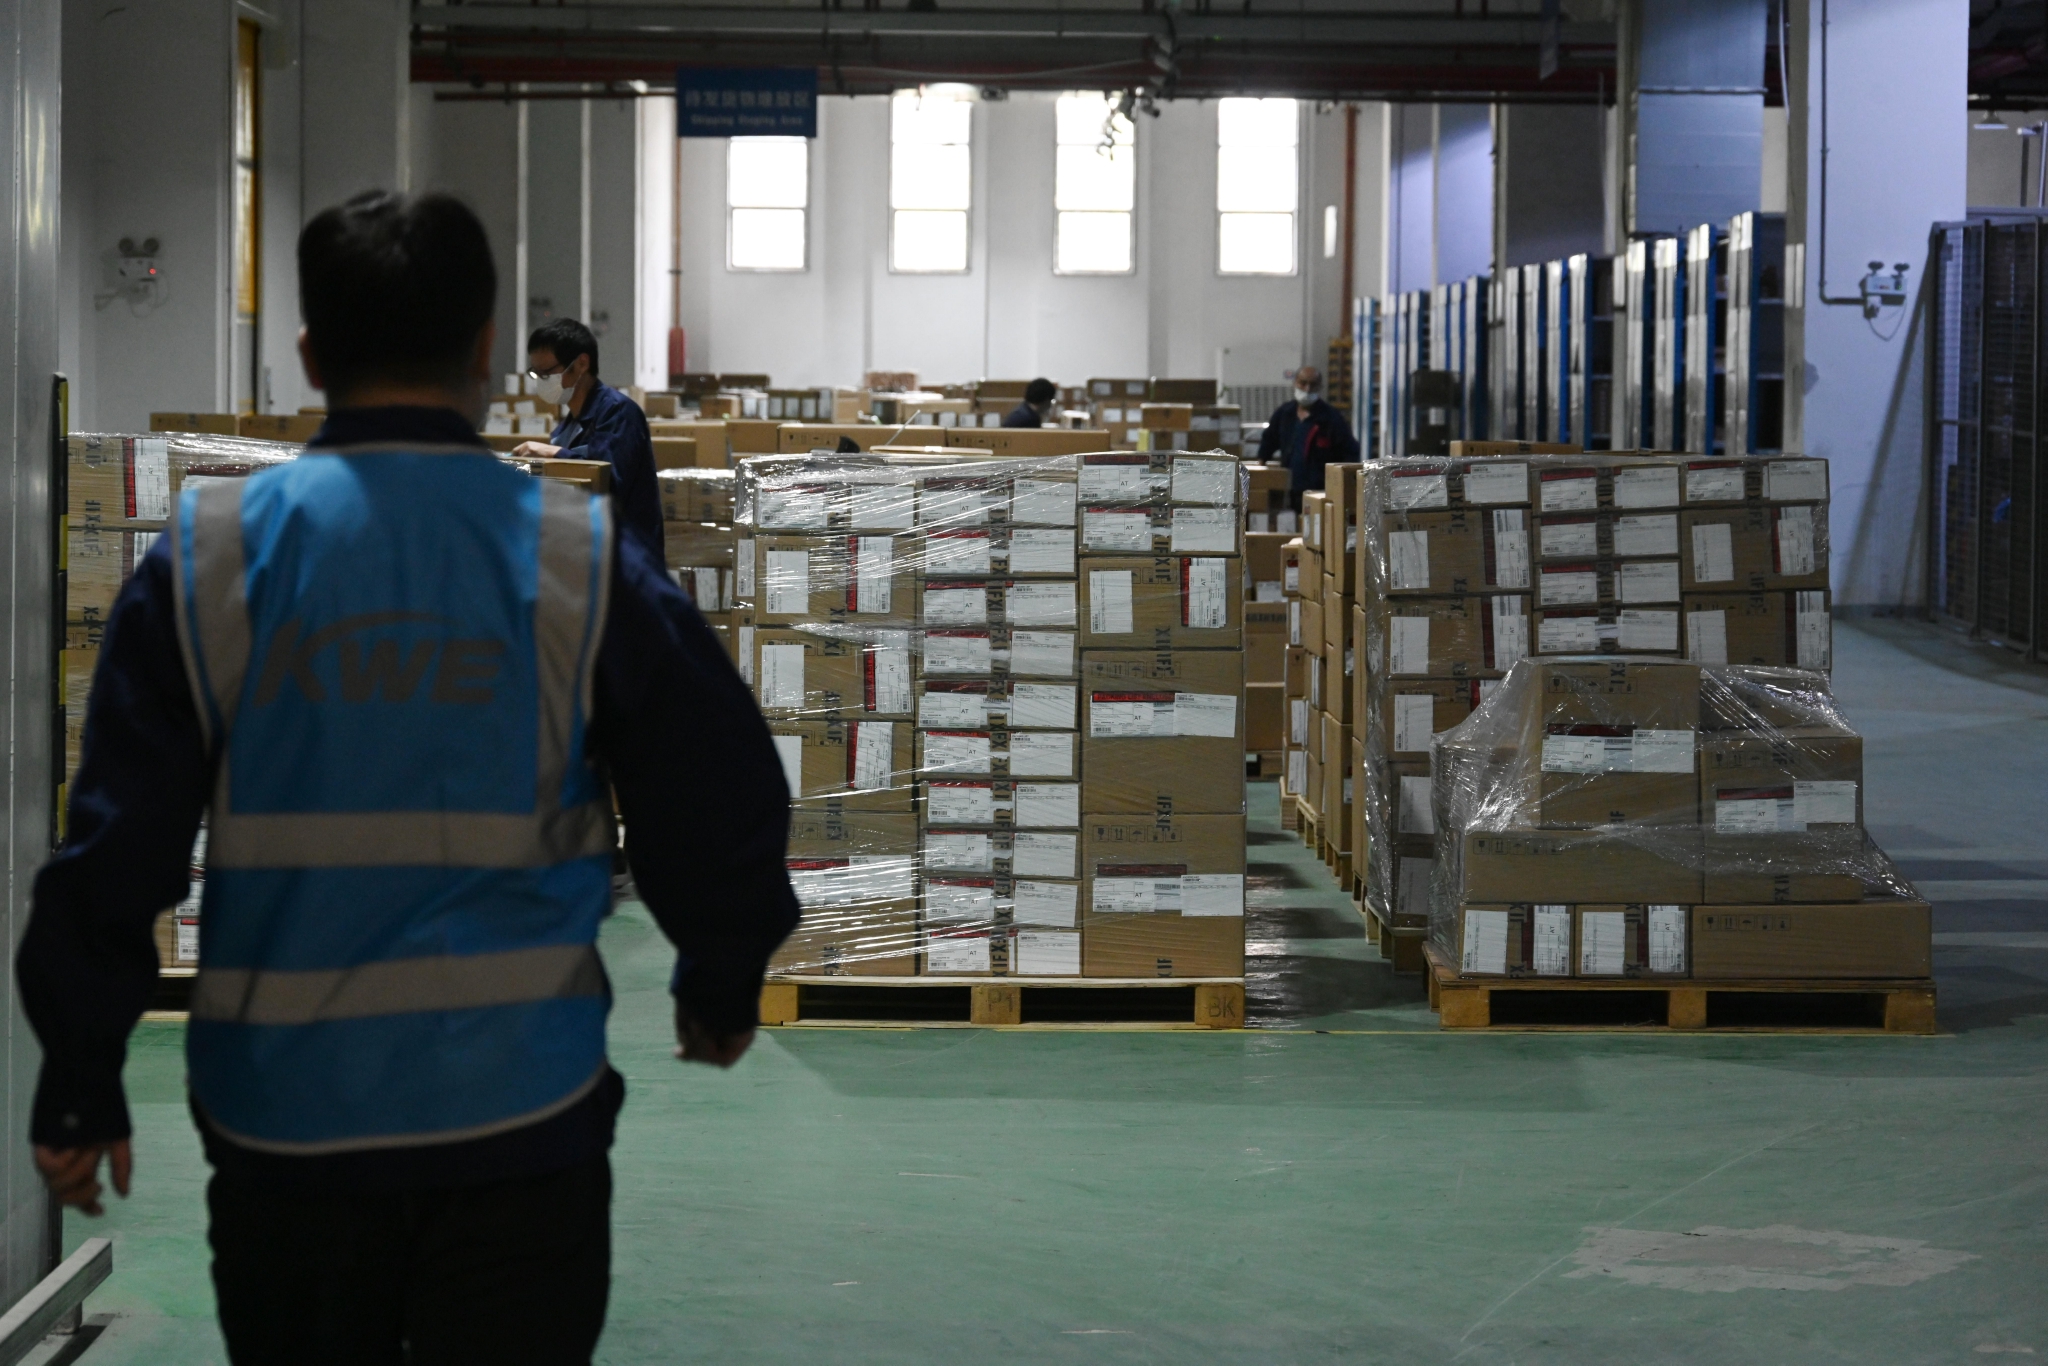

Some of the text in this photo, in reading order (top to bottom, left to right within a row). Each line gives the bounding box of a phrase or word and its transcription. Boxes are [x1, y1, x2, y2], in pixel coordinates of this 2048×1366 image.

[253, 612, 505, 706] KWE
[987, 988, 1014, 1013] P1
[1206, 996, 1236, 1019] BK
